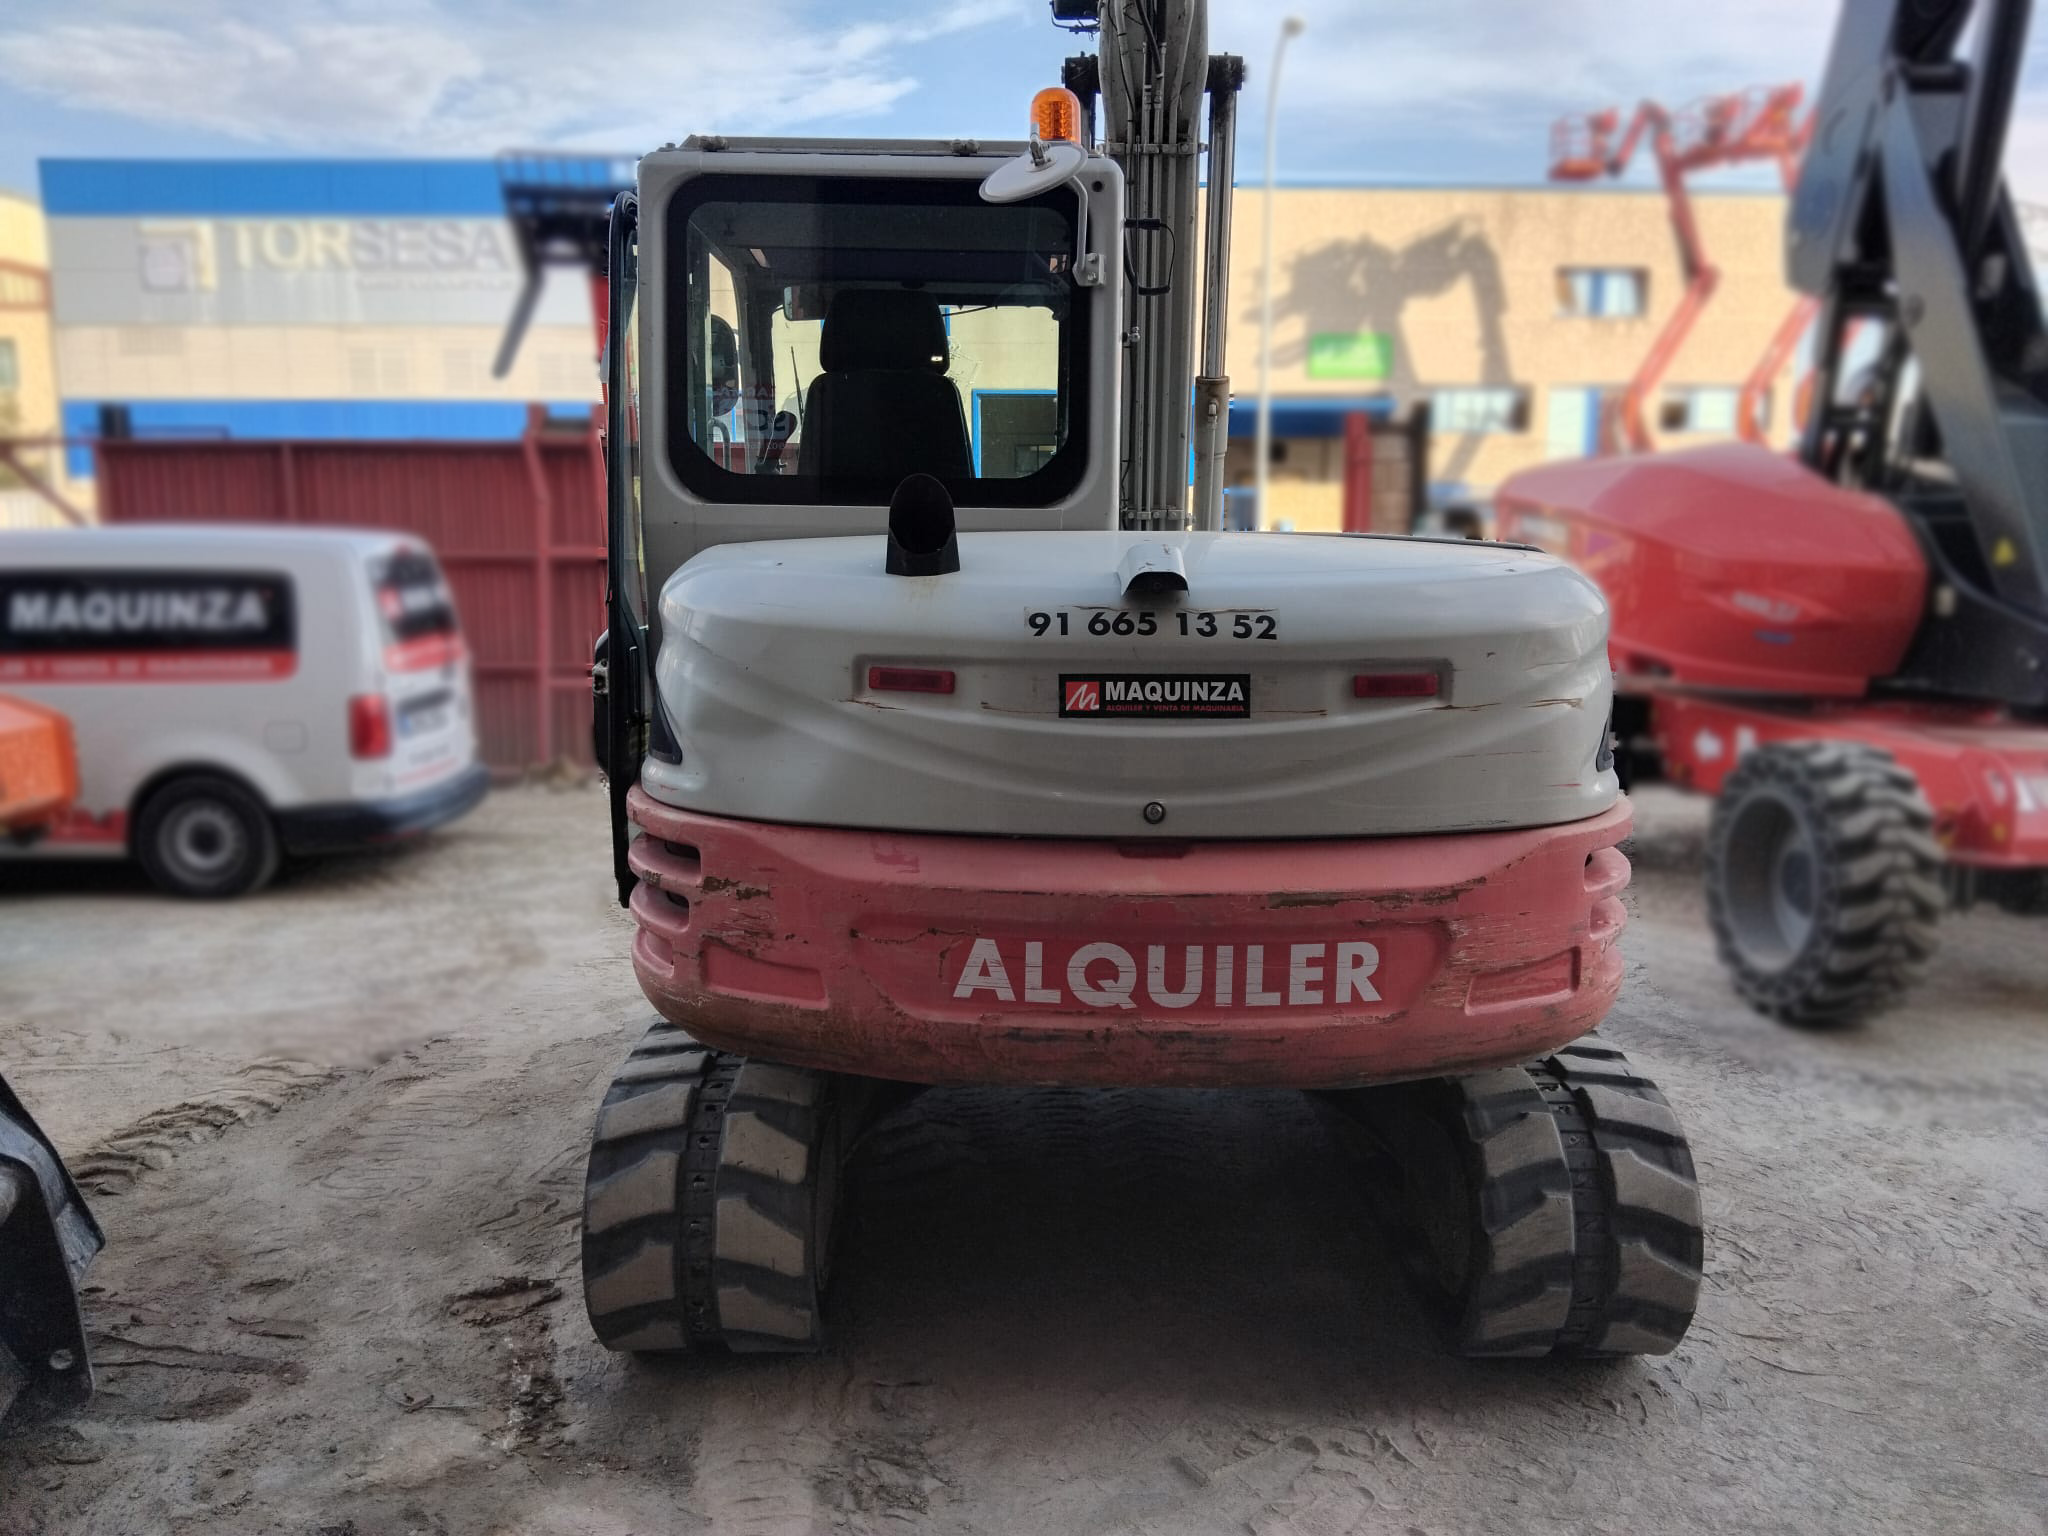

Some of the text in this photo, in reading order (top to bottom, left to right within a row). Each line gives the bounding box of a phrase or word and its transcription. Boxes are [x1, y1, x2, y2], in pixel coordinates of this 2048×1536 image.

[228, 219, 512, 271] TORSESA
[9, 592, 267, 631] MAQUINZA
[1028, 611, 1278, 640] 91 665 13 52
[1105, 681, 1244, 703] MAQUINZA
[1106, 704, 1244, 712] ALQUILER Y VENTA DE MAQUINARIA
[953, 938, 1382, 1010] ALQUILER
